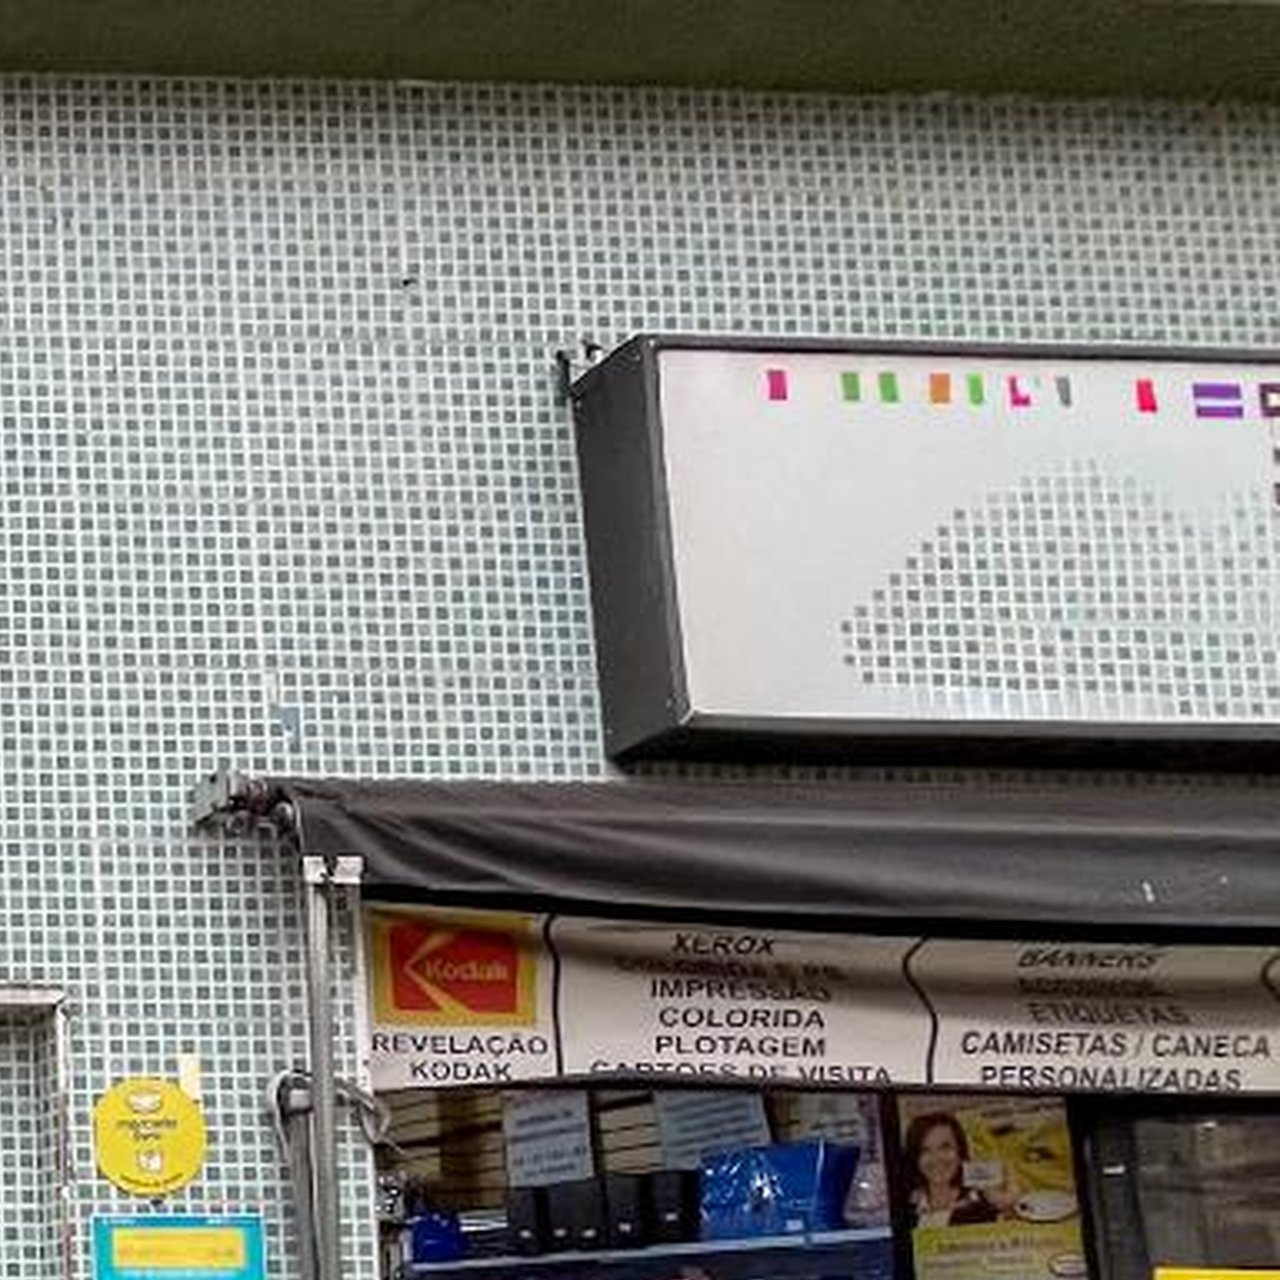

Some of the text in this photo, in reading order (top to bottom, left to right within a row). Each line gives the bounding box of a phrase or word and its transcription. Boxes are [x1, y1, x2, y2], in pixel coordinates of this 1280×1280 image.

[658, 1008, 826, 1029] COLORIDA
[371, 1032, 549, 1058] REVELAÇÃO
[655, 1035, 826, 1057] PLOTAGEM
[961, 1031, 1128, 1057] CAMISETAS
[1152, 1034, 1271, 1058] CANECA
[410, 1060, 513, 1081] KODAK
[981, 1065, 1242, 1091] PERSONALIZADAS
